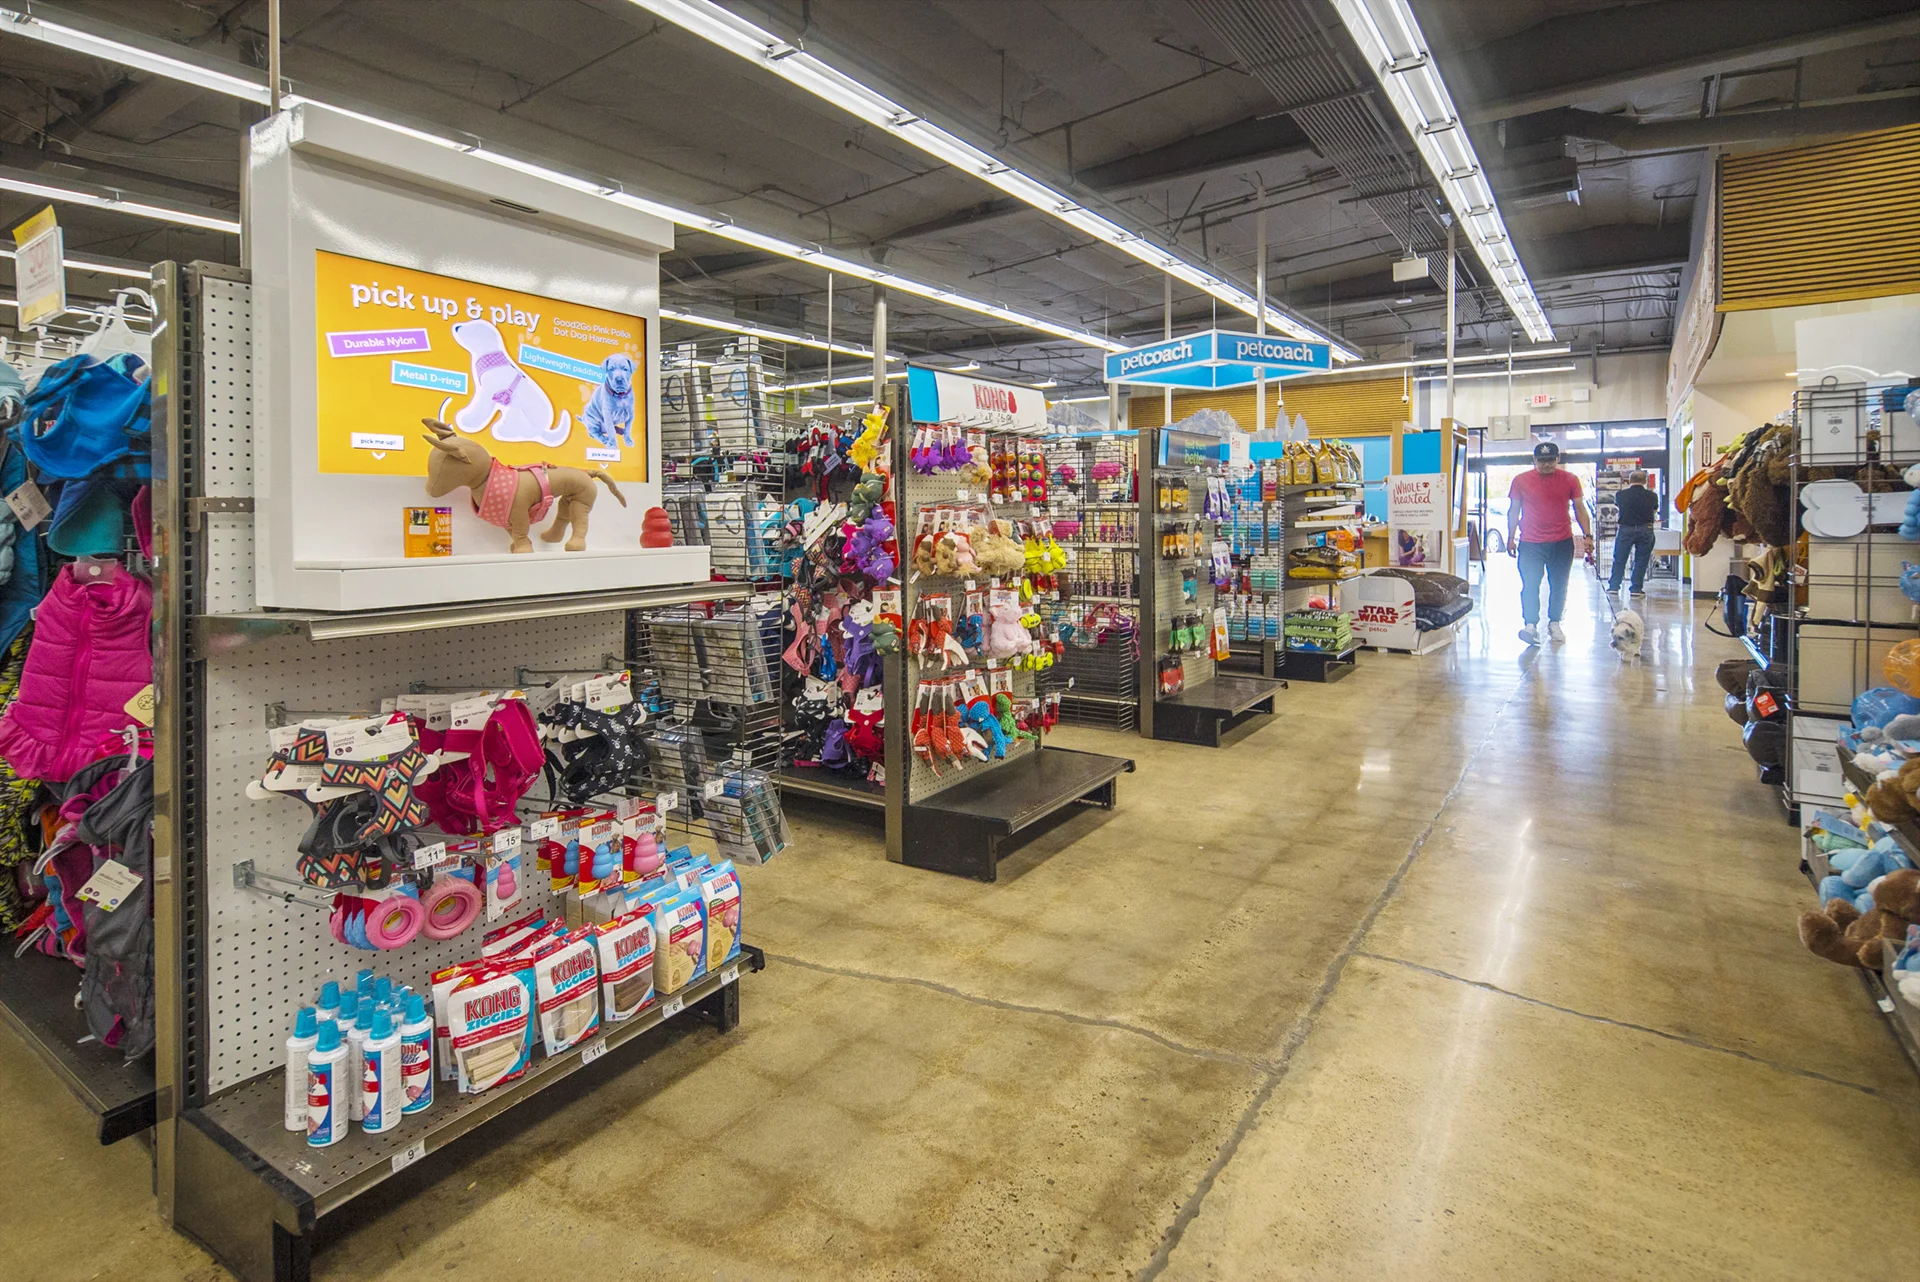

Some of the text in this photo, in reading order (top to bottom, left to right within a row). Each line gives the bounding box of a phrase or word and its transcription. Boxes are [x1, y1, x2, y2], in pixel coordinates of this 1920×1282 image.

[350, 281, 540, 333] pick up & play
[553, 317, 631, 339] Good2Go Pink Polka
[343, 336, 417, 349] Durable Nylon
[553, 327, 619, 346] Dot Dog Harness
[1120, 341, 1193, 374] petcoach
[1236, 340, 1314, 363] petcoach
[524, 351, 603, 380] Lightweight padding
[399, 368, 461, 388] Metal D-ring
[973, 384, 1008, 413] KONG
[1534, 395, 1547, 403] EXIT
[1184, 449, 1206, 465] better
[1395, 481, 1421, 495] WHOLE
[1393, 489, 1432, 505] hearted
[1358, 605, 1398, 616] STAR
[1358, 613, 1398, 624] WARS
[333, 736, 355, 744] comfort
[591, 822, 612, 836] KONG
[635, 815, 655, 828] KONG
[506, 837, 516, 846] 15
[427, 850, 439, 861] 11
[711, 873, 731, 891] KONG
[714, 882, 733, 895] SNACKS
[676, 902, 696, 919] KONG
[678, 911, 698, 924] SNACKS
[613, 926, 650, 961] KONG
[617, 944, 652, 969] ZIGGIES
[551, 949, 595, 987] KONG
[554, 967, 596, 995] ZIGGIES
[464, 984, 521, 1022] KONG
[672, 1003, 678, 1011] 6
[466, 1006, 521, 1032] ZIGGIES
[401, 1043, 421, 1055] ONG
[591, 1046, 600, 1057] 11
[408, 1150, 414, 1160] 9
